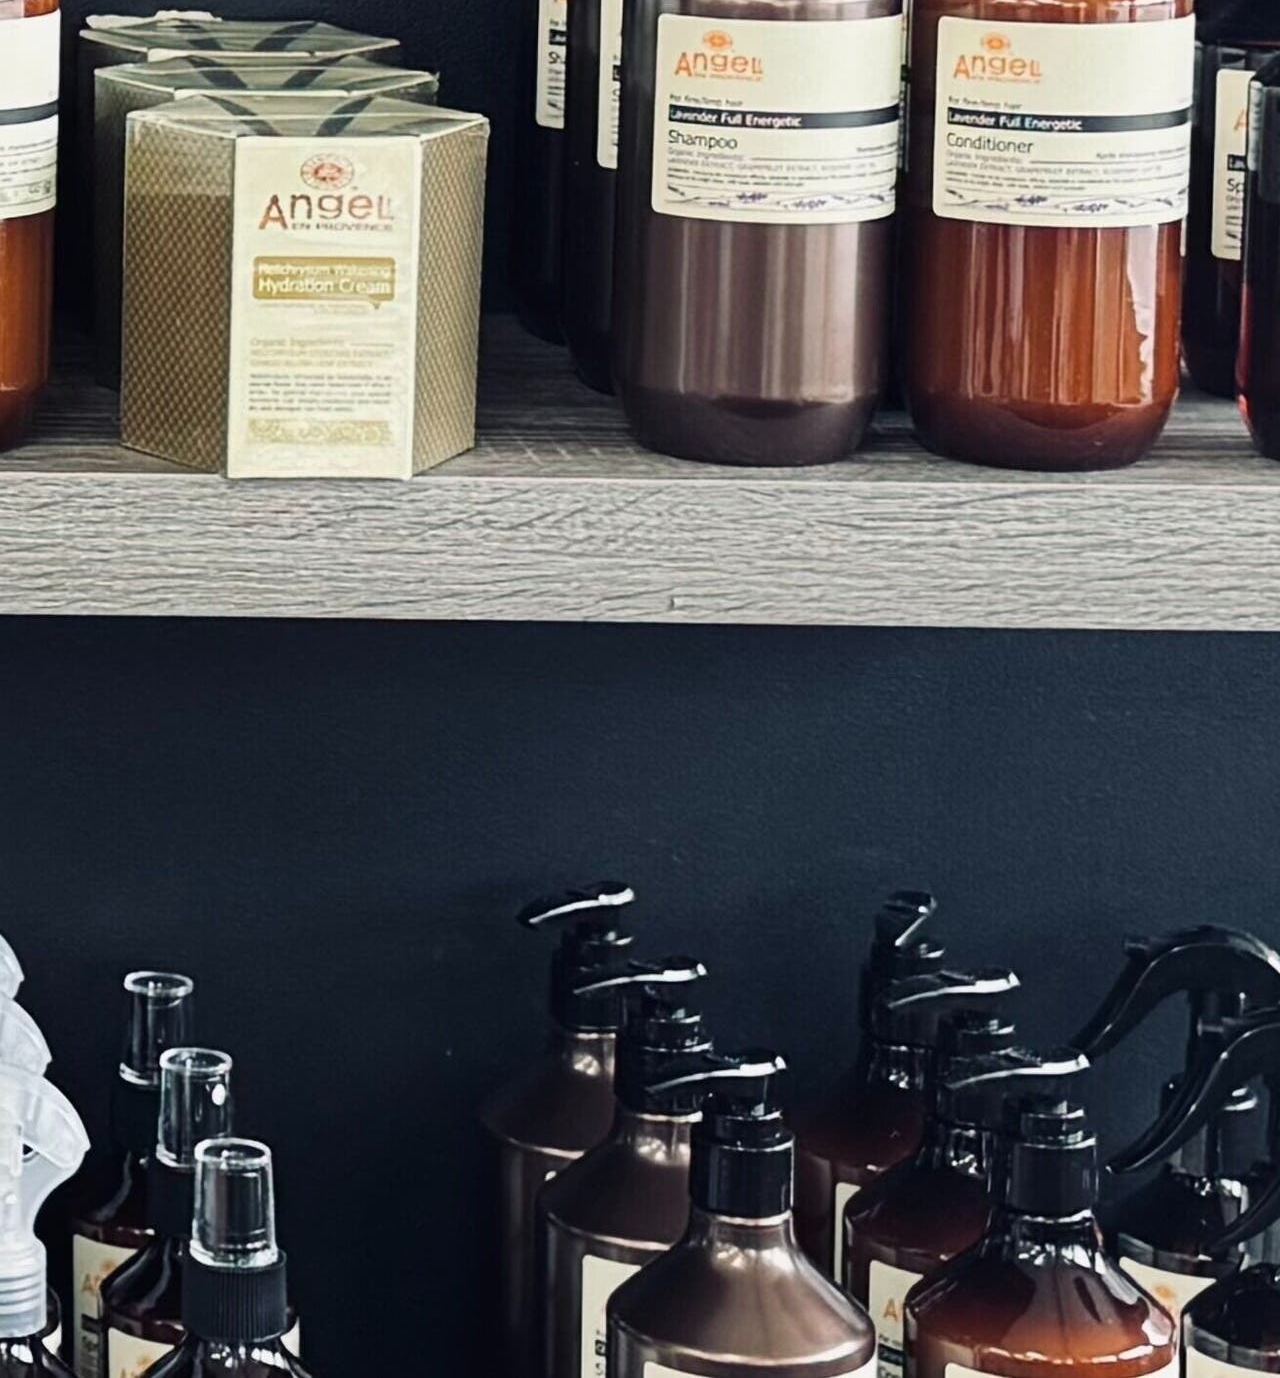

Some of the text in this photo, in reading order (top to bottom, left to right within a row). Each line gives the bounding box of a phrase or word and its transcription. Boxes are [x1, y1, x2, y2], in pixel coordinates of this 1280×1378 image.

[669, 109, 802, 129] Lavender Full Energetic
[948, 110, 1083, 132] Lavender Full Energetic
[667, 129, 738, 151] Shampoo
[946, 132, 1034, 155] Conditioner
[258, 277, 391, 294] Hydration Cream
